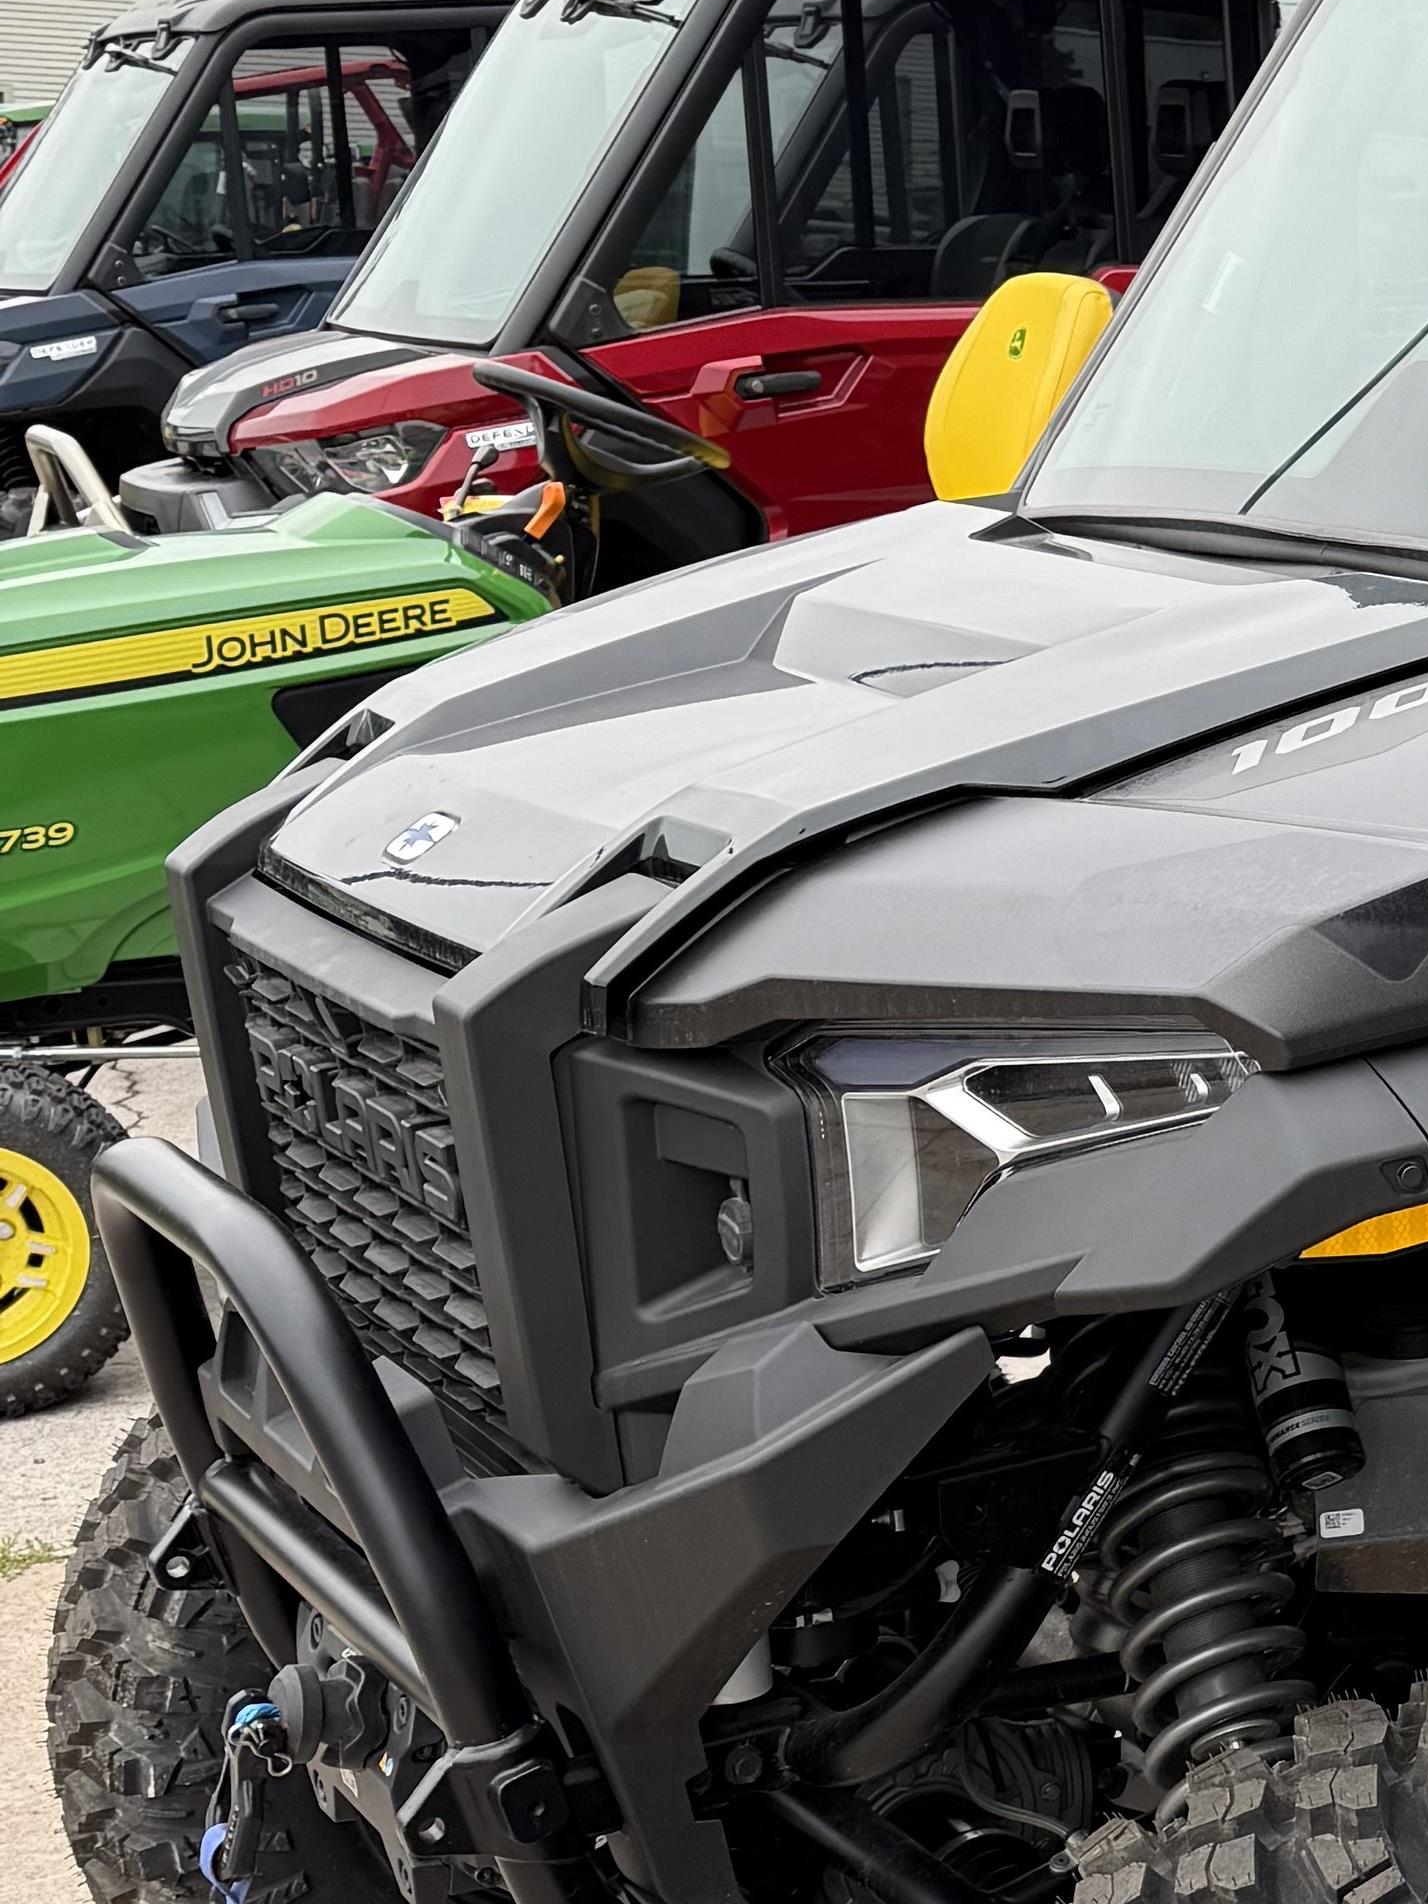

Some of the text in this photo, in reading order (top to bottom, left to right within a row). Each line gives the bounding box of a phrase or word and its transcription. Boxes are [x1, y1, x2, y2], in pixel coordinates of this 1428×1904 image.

[261, 369, 318, 398] HD10
[191, 599, 452, 669] JOHN DEERE
[247, 1024, 457, 1220] POLARIS
[1041, 1470, 1115, 1572] POLARIS
